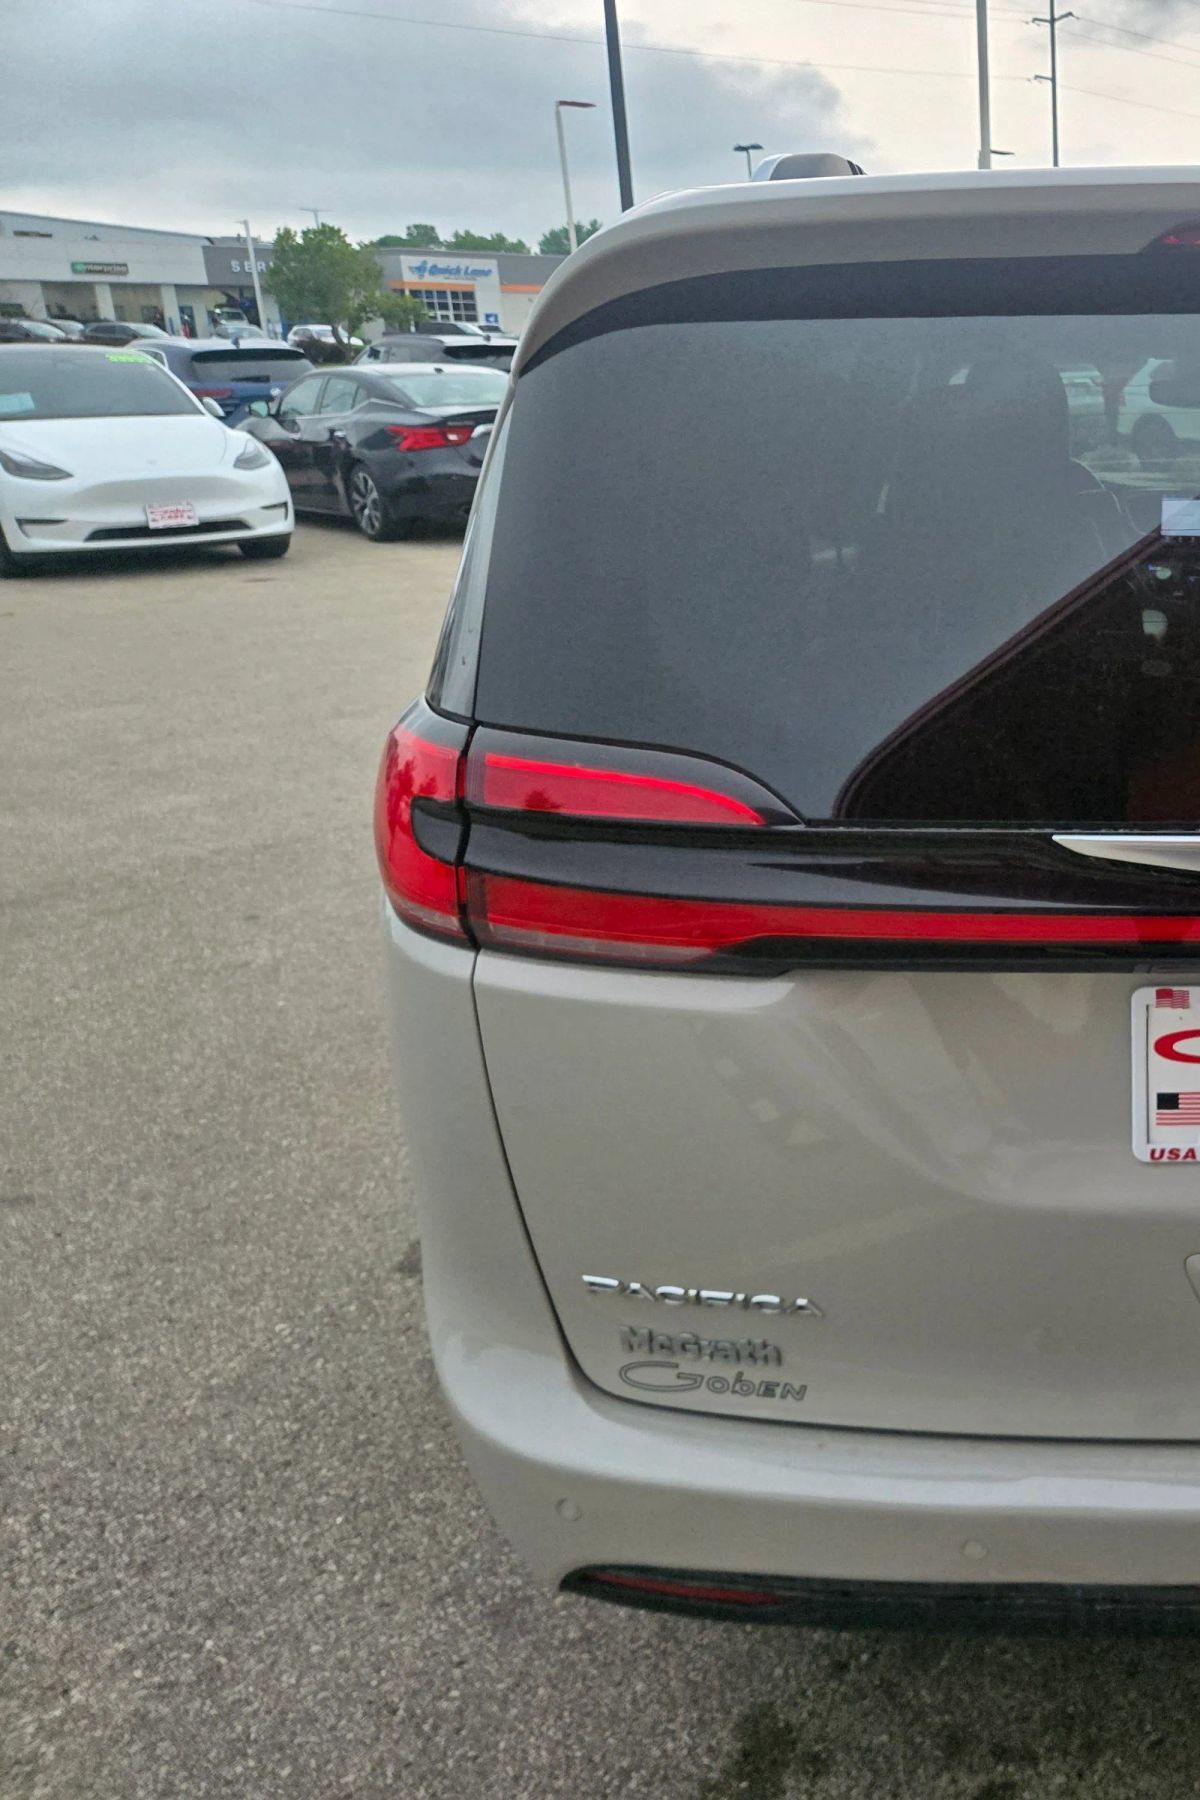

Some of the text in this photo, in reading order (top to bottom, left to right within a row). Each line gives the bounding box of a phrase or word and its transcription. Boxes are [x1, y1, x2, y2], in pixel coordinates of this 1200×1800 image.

[1149, 1146, 1197, 1161] USA
[581, 1274, 824, 1318] PACIFICA
[619, 1325, 783, 1366] McGrath
